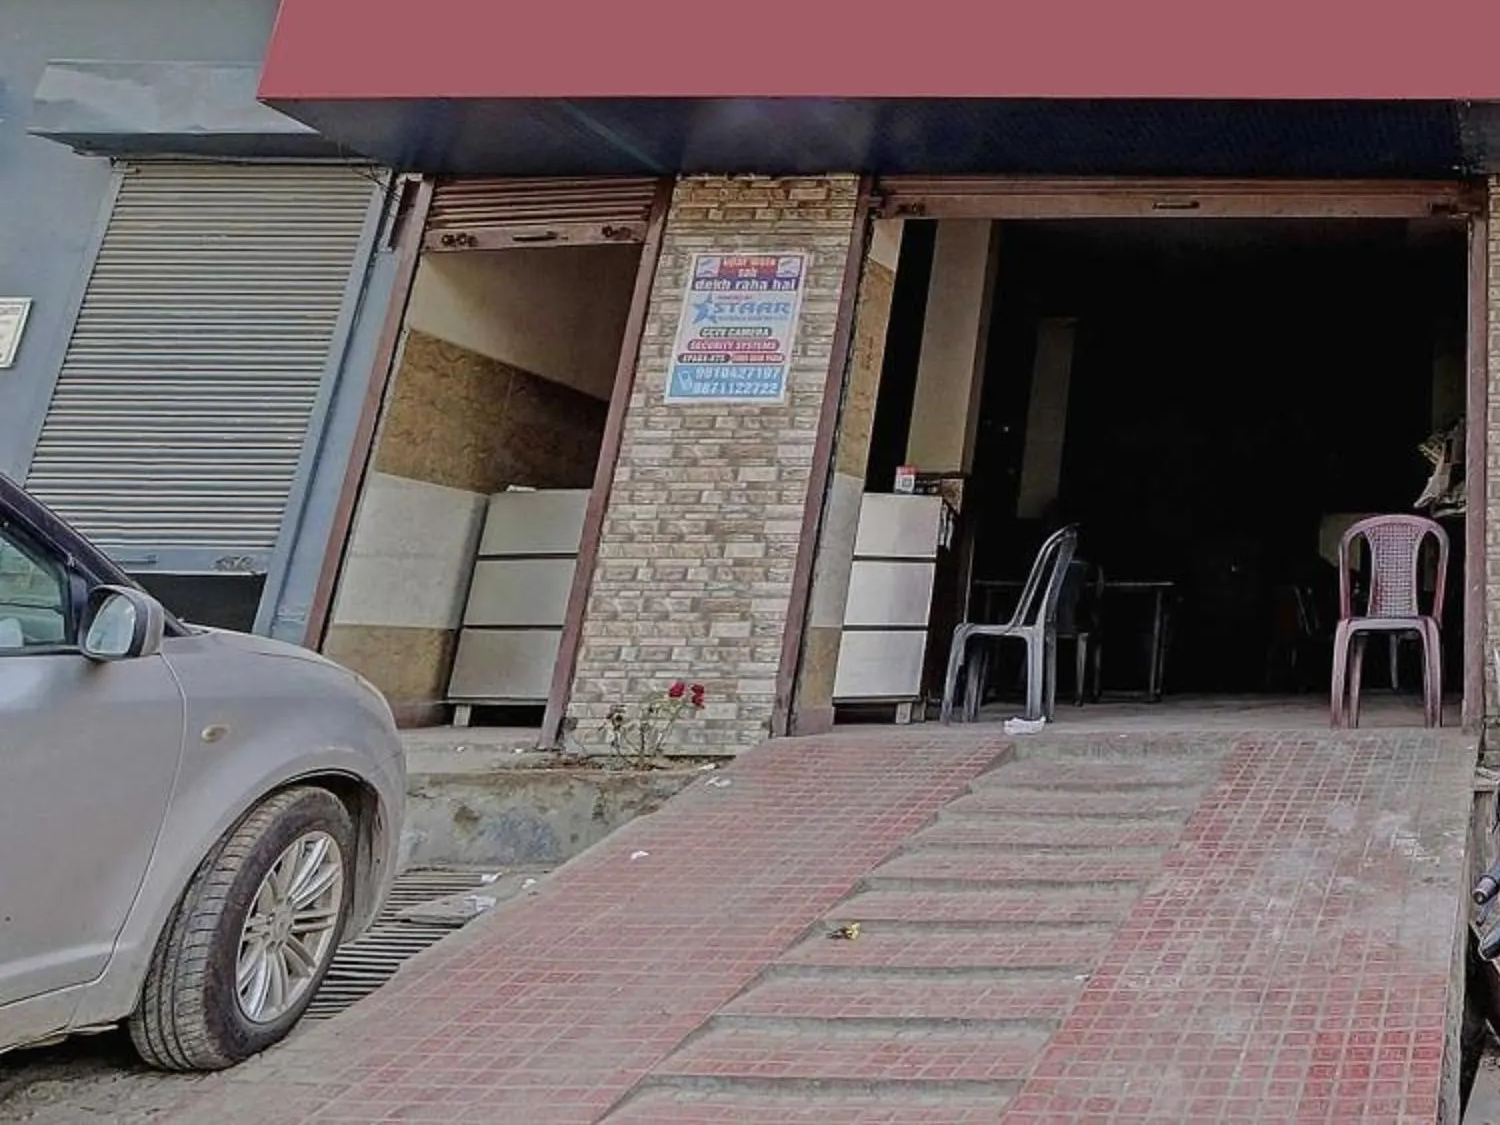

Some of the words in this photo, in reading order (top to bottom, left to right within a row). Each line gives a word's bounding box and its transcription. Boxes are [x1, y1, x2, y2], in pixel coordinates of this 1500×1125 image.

[735, 278, 768, 291] raha
[772, 277, 797, 290] hai
[713, 302, 791, 314] STAAR
[702, 327, 727, 337] CCTV
